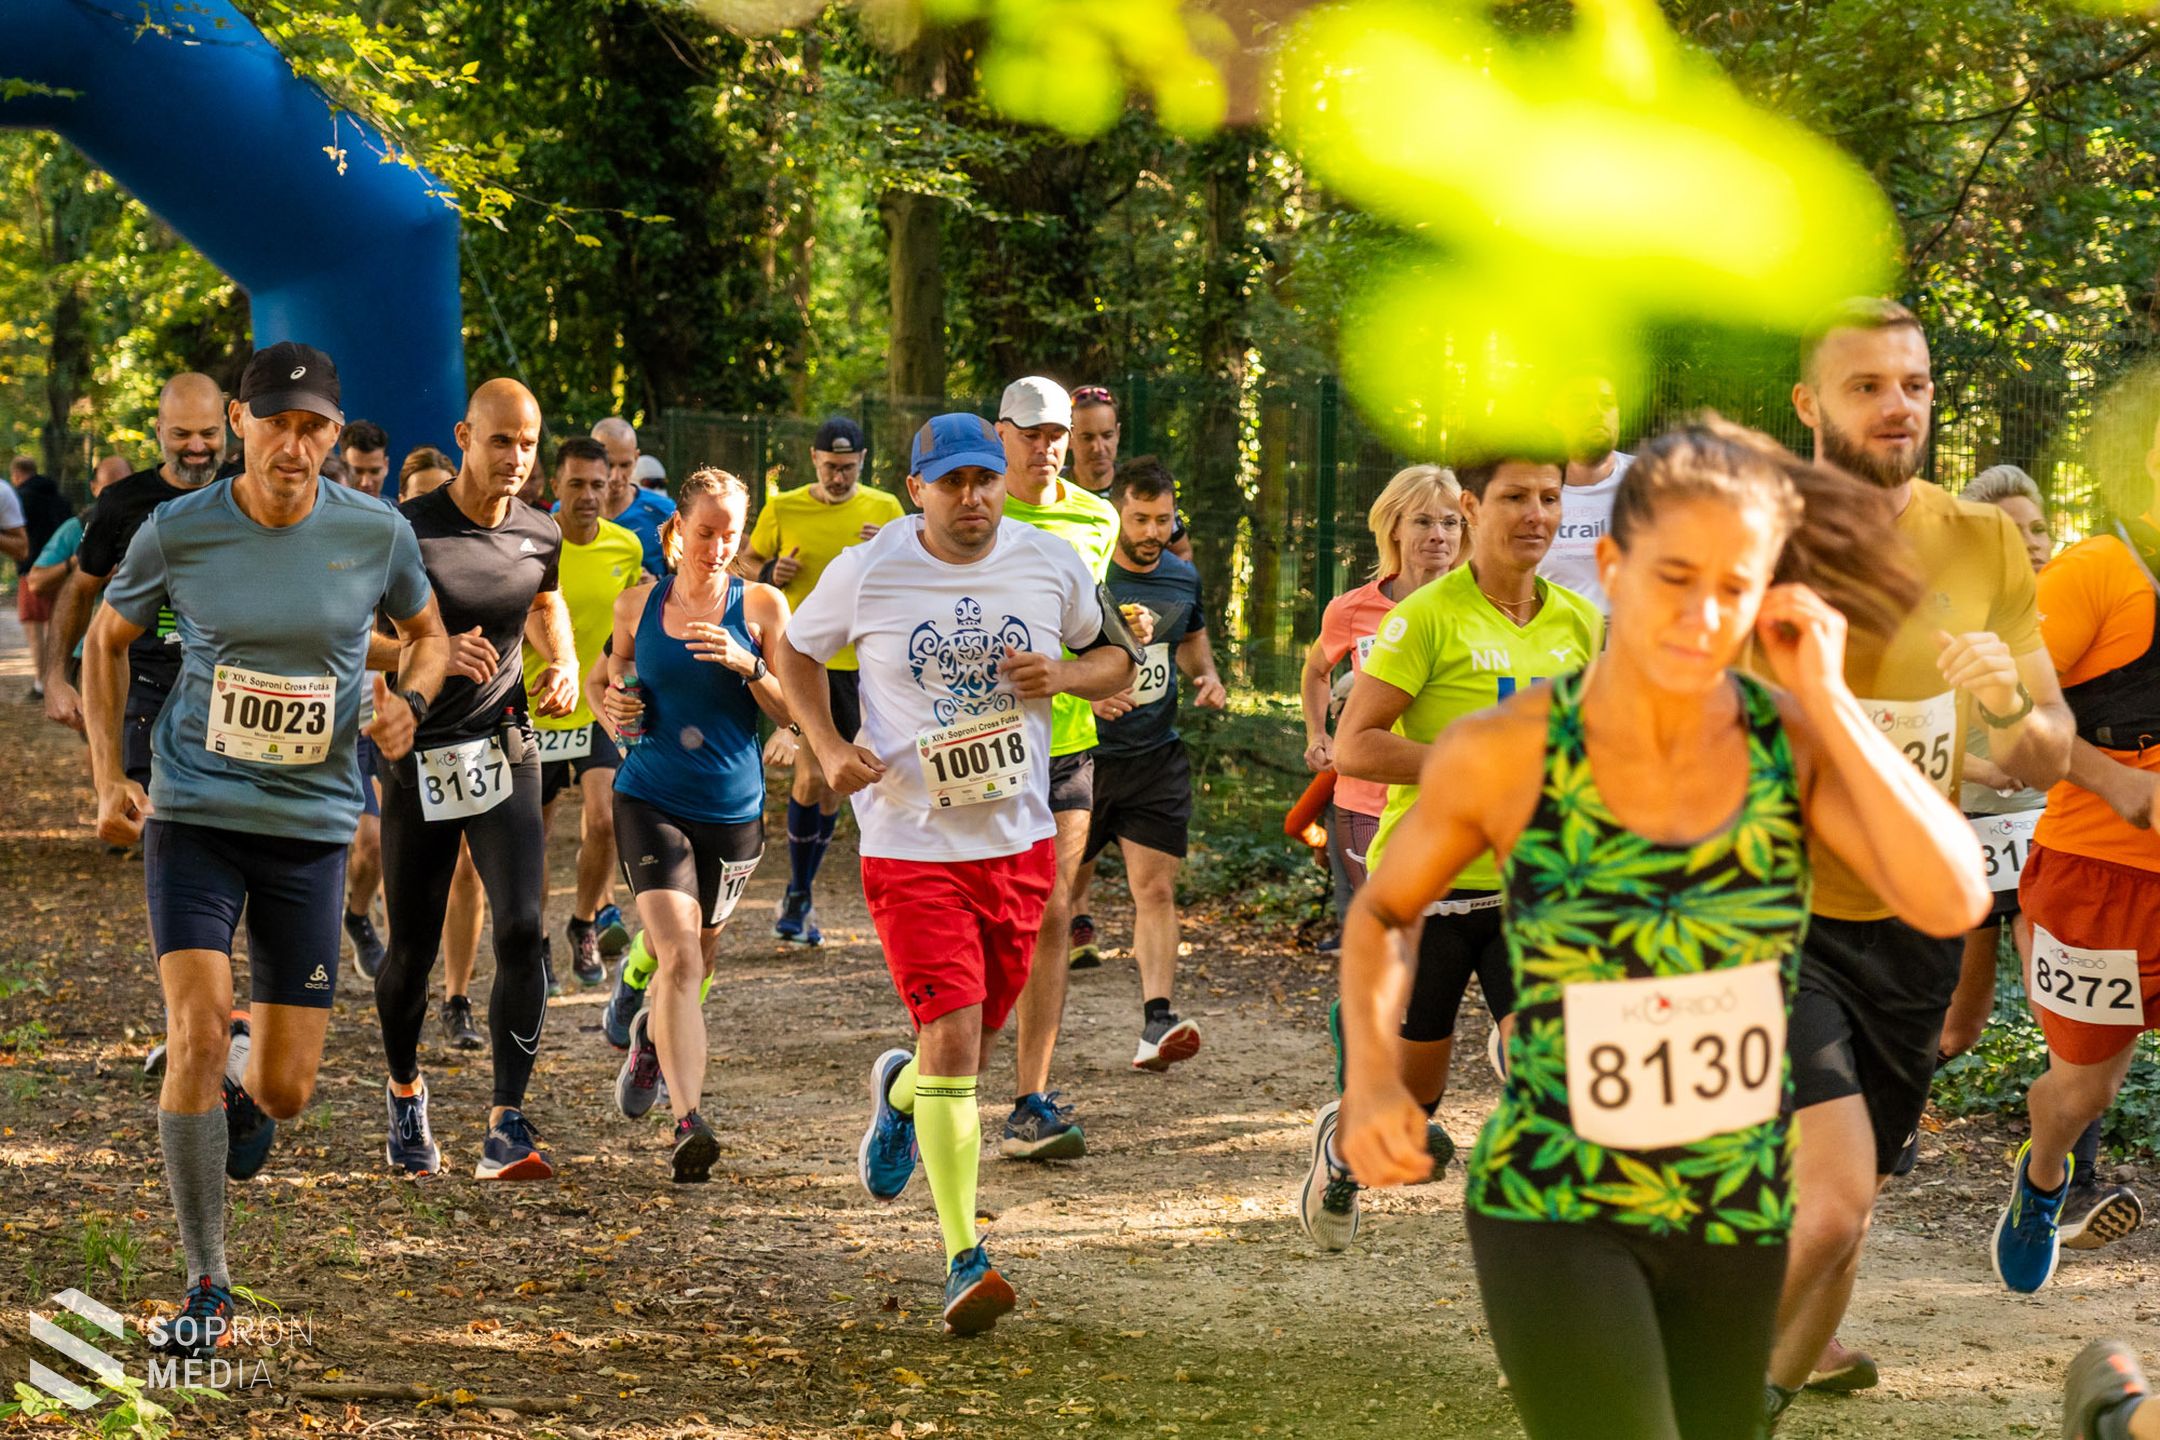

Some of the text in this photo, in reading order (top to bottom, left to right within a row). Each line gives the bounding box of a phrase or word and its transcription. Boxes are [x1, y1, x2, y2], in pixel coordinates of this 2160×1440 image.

[1559, 519, 1605, 538] trail
[232, 673, 248, 684] XIV.
[249, 676, 282, 690] Soproni
[284, 682, 307, 691] Cross
[221, 691, 326, 736] 10023
[931, 733, 946, 743] XIV.
[947, 726, 978, 740] Soproni
[978, 720, 1000, 731] Cross
[929, 731, 1026, 783] 10018
[425, 761, 504, 805] 8137
[2037, 956, 2135, 1009] 8272
[1588, 1026, 1771, 1111] 8130
